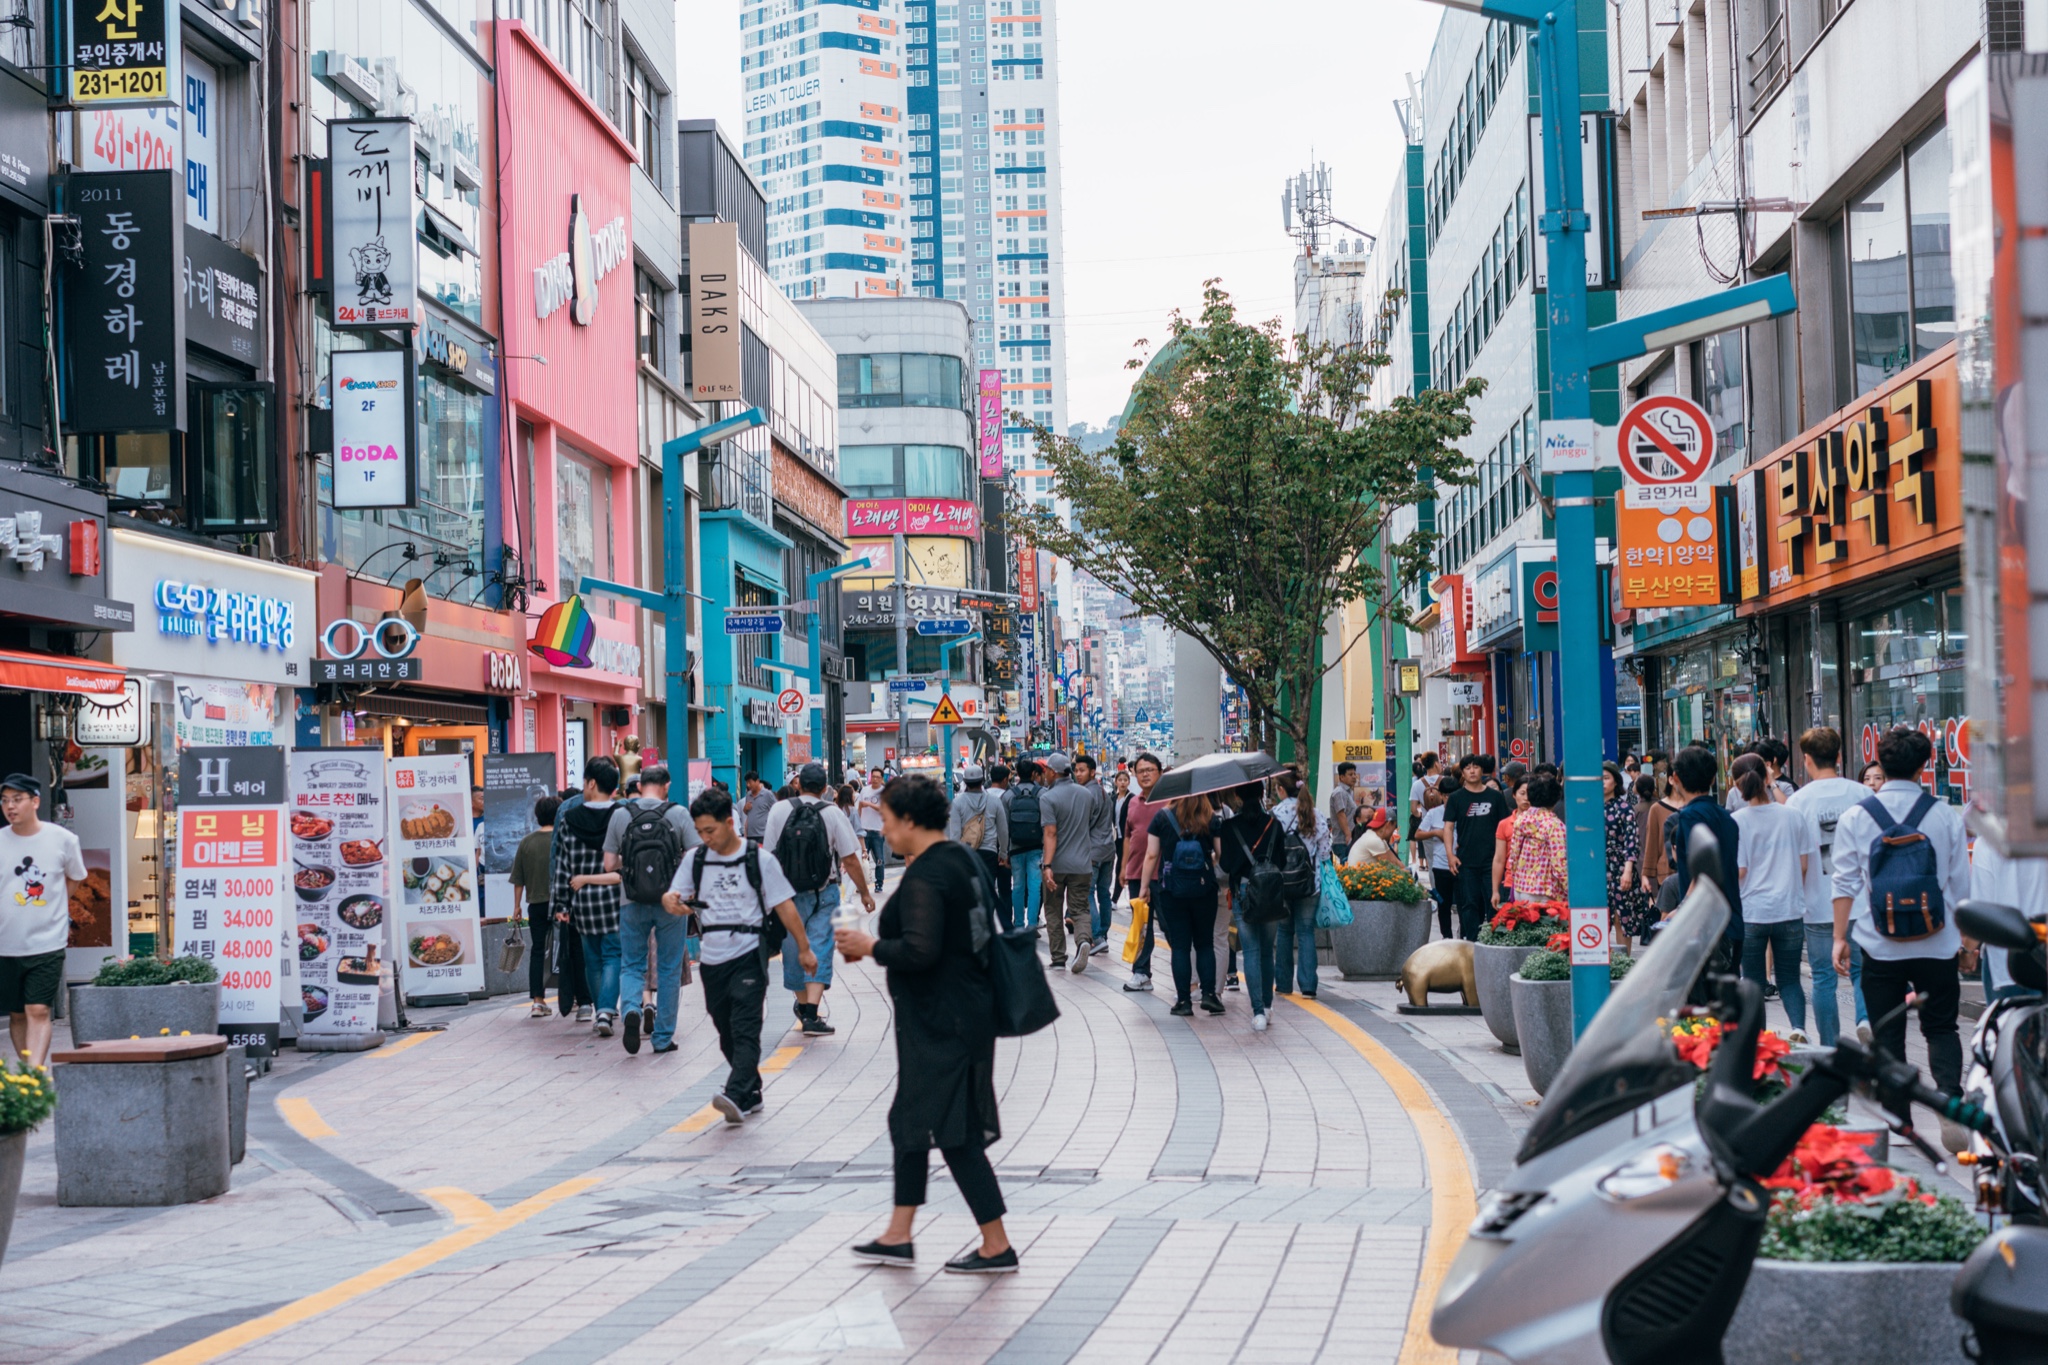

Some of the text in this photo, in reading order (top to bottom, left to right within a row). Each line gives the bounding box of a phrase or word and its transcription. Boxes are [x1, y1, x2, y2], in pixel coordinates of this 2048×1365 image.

[95, 0, 144, 40] 산
[76, 41, 164, 67] 공인중개사
[79, 71, 163, 96] 231-1201
[745, 78, 821, 114] LEEIN TOWER
[81, 188, 123, 202] 2011
[592, 216, 627, 281] DONG
[101, 211, 144, 390] 동경하레
[700, 273, 728, 334] DAKS
[365, 309, 377, 322] 룸
[377, 306, 409, 320] 보드카페
[448, 340, 468, 374] SHOP
[151, 361, 168, 416] 남포본점
[347, 380, 398, 391] GACHA SHOP
[707, 384, 734, 393] LF 닥스
[980, 389, 1001, 399] 에이스
[361, 400, 376, 412] 2F
[983, 399, 1001, 465] 노래방
[1545, 434, 1576, 449] Nice
[1552, 448, 1588, 459] junggu
[363, 470, 376, 482] 1F
[1777, 379, 1938, 577] 부산약국
[1637, 485, 1698, 501] 금연거리
[856, 501, 880, 509] 에이스
[851, 508, 901, 531] 노래방
[908, 502, 974, 531] 에이스 노래방
[1626, 574, 1717, 600] 부산약국
[857, 594, 893, 612] 의원
[206, 587, 295, 650] 갤러리안경
[727, 617, 765, 627] 국제시장2길
[848, 613, 897, 625] 246-287
[933, 621, 956, 629] 중구로
[992, 603, 1012, 679] 노래주점
[323, 662, 410, 680] 갤러리안경
[195, 757, 232, 797] H
[307, 782, 318, 790] 오늘
[417, 775, 457, 788] 동경하레
[233, 780, 266, 796] 헤어
[297, 793, 380, 806] 베스트 추천 메뉴
[193, 840, 265, 864] 이벤트
[414, 838, 457, 850] 멘치카츠카레
[184, 878, 274, 899] 염색 30,000
[419, 904, 461, 915] 치즈카츠정식
[192, 908, 274, 930] 펌 34,000
[221, 939, 273, 960] 48,000
[220, 969, 273, 990] 49,000
[236, 999, 256, 1012] 이전
